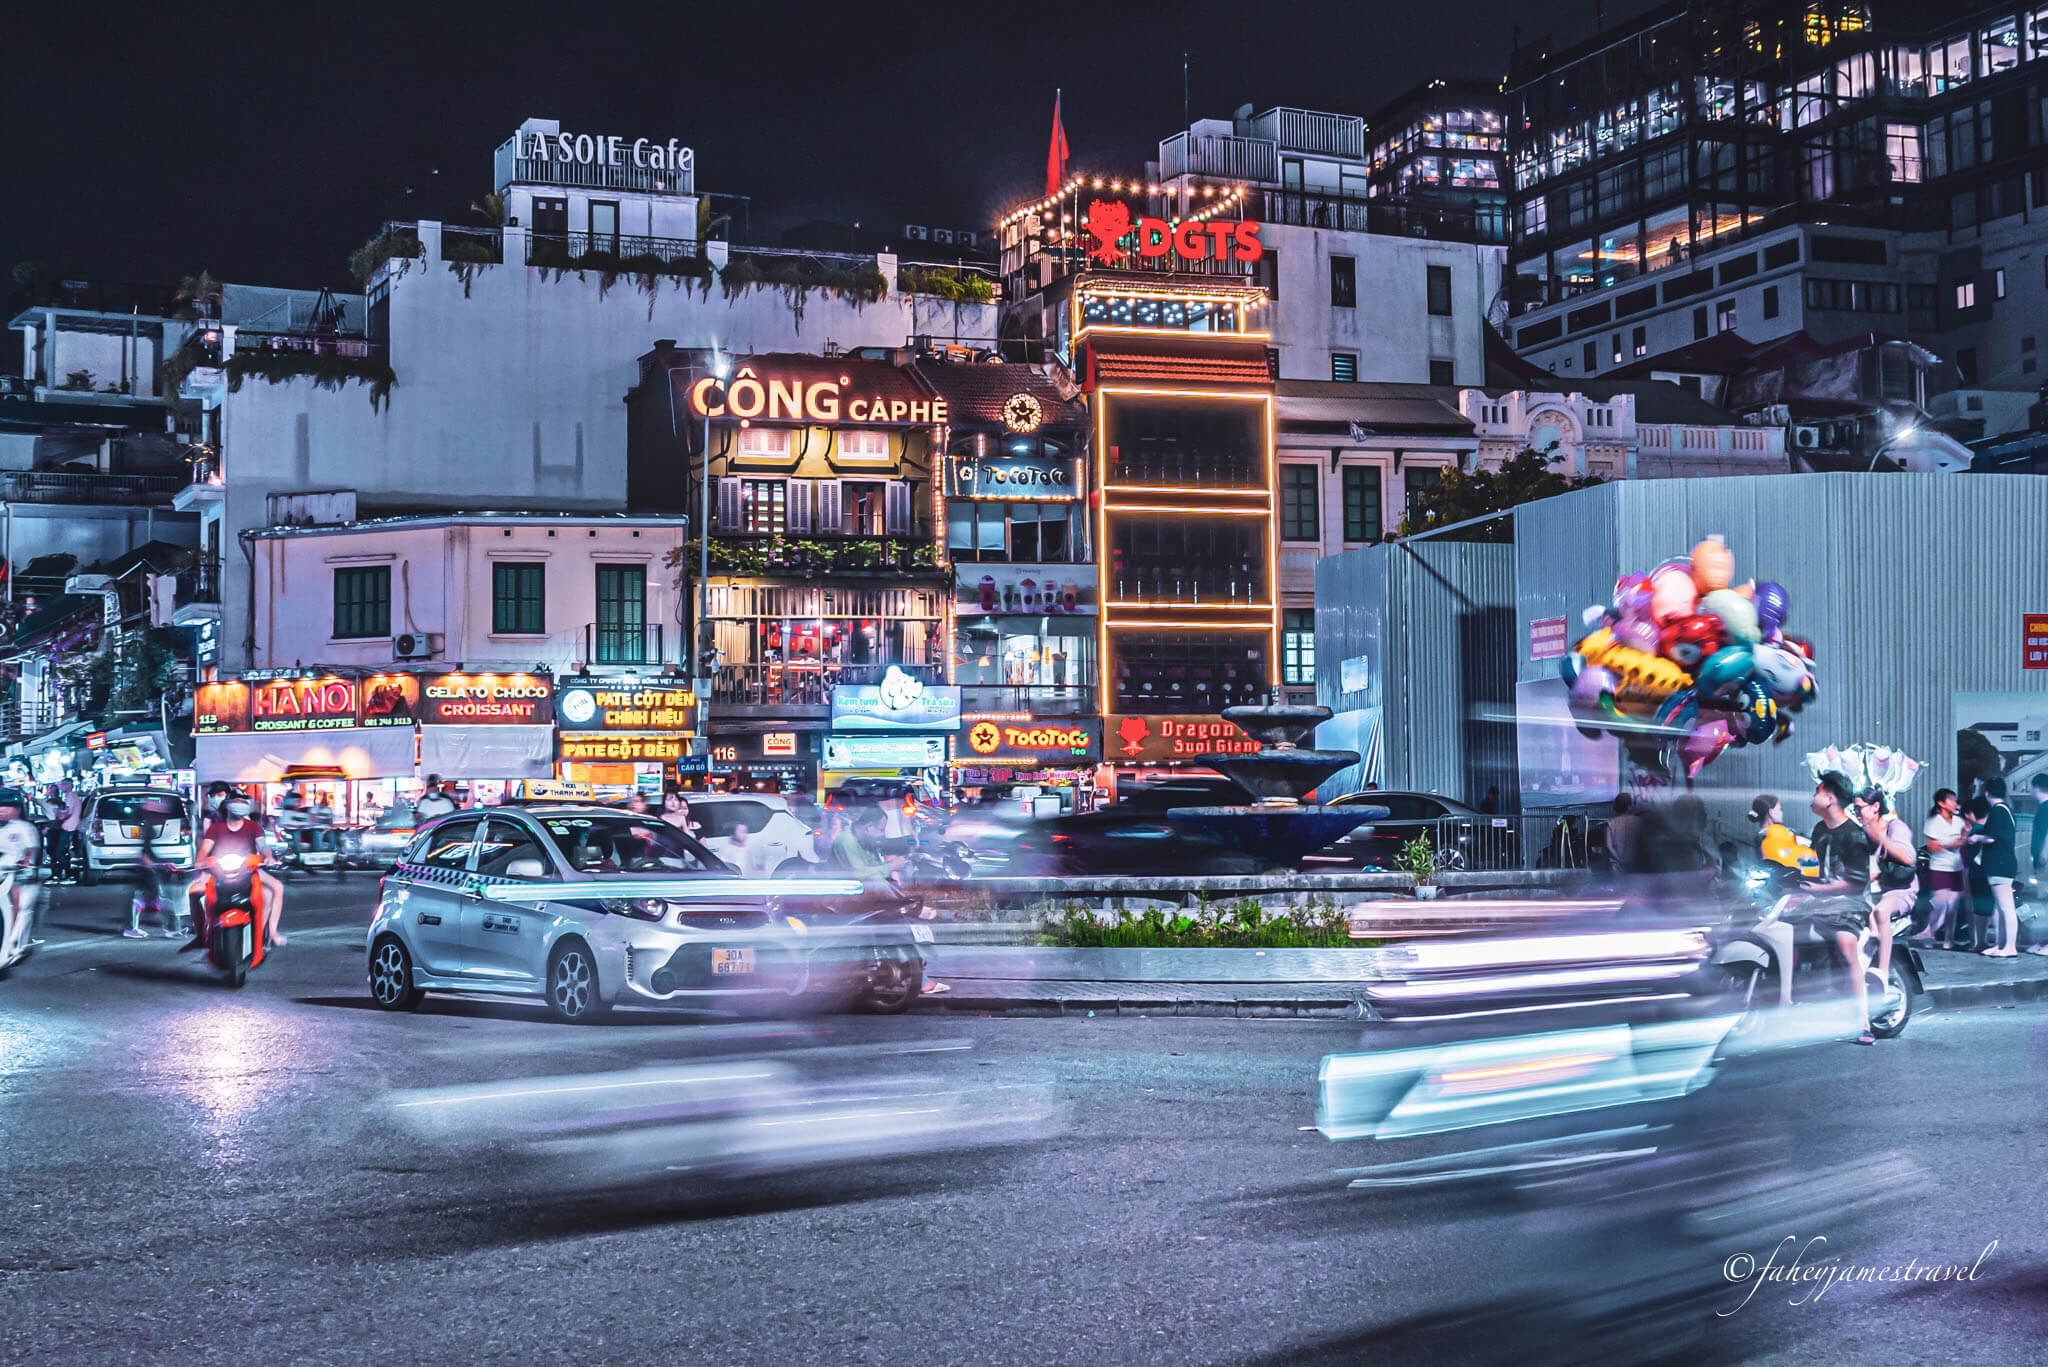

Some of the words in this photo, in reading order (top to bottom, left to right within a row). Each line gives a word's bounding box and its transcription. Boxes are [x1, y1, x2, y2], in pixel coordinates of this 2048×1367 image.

[515, 129, 549, 161] LA
[558, 132, 623, 166] SOIE
[633, 138, 692, 171] Cafe
[1139, 217, 1263, 263] DGTS
[692, 368, 839, 428] CỘNG
[425, 686, 489, 699] GELATO
[493, 686, 548, 699] CHOCO
[596, 691, 632, 707] PATE
[633, 689, 664, 709] CỘT
[440, 703, 536, 716] CROISSANT
[605, 708, 649, 725] CHÍNH
[650, 708, 684, 727] HIỆU
[316, 717, 355, 729] COFFEE
[1161, 720, 1235, 738] Dragon
[563, 743, 607, 758] PATE
[607, 741, 643, 760] CỘT
[713, 747, 737, 761] 116
[550, 789, 574, 797] THANH
[726, 950, 743, 961] 30A
